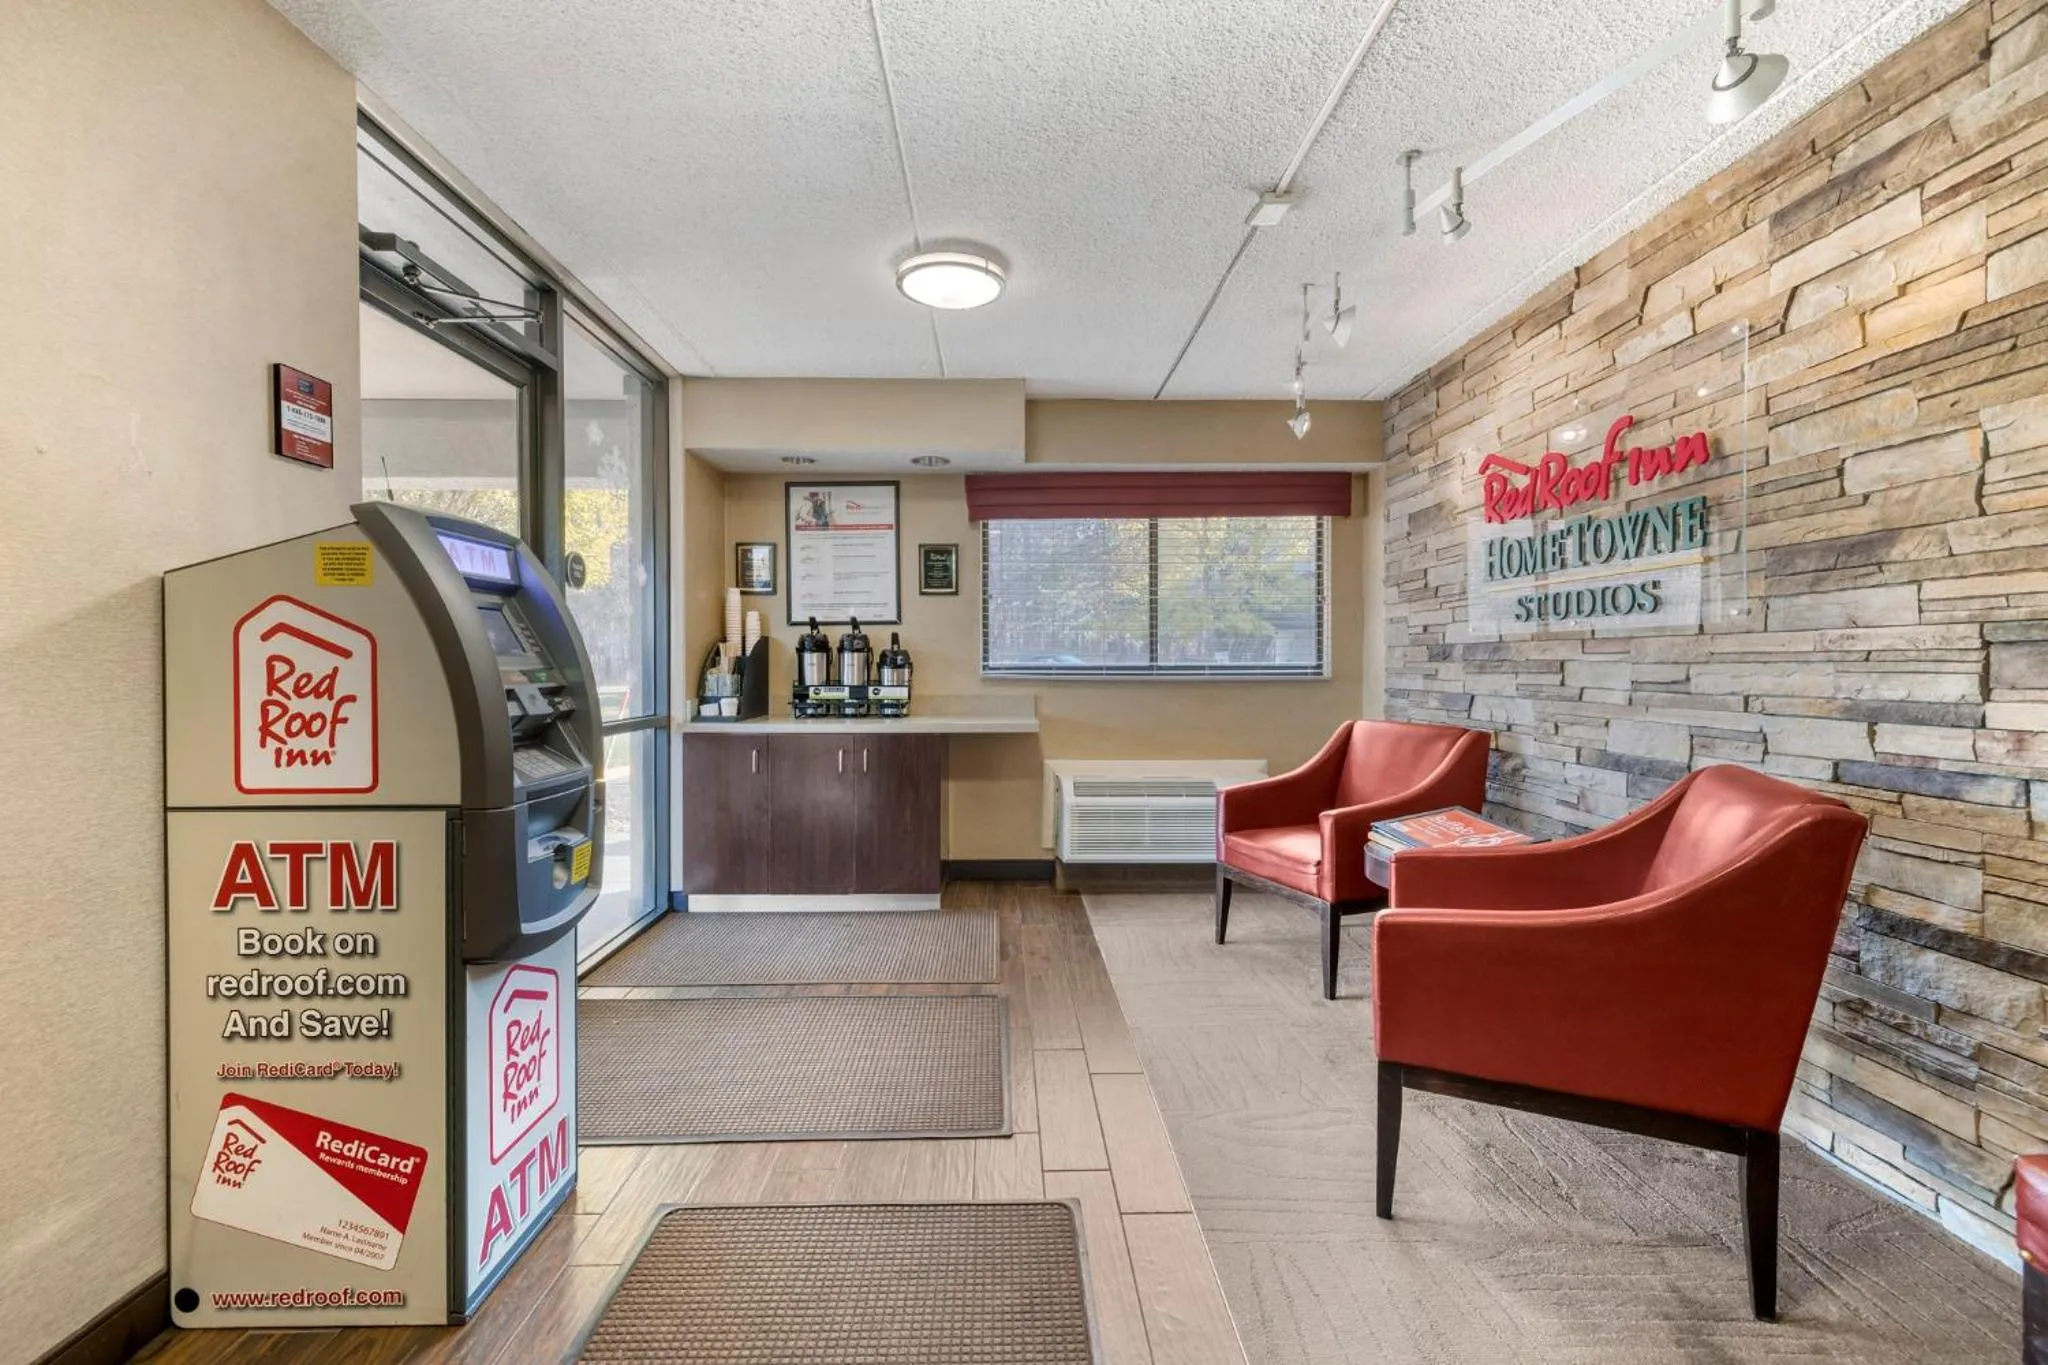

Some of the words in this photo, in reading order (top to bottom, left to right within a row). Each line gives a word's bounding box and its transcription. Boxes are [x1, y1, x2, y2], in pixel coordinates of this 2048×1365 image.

[1483, 468, 1539, 525] Red
[1539, 415, 1635, 511] Roof
[1628, 431, 1711, 486] Inn
[1483, 495, 1708, 583] HOMETOWNE
[1515, 579, 1661, 623] STUDIOS
[265, 654, 339, 701] Red
[258, 694, 358, 749] Roof
[210, 840, 398, 911] ATM
[237, 926, 325, 957] Book
[332, 932, 376, 956] on
[206, 967, 407, 998] redroof.com
[221, 1008, 290, 1039] And
[299, 1008, 391, 1039] Save!
[505, 1009, 543, 1062] Red
[216, 1062, 251, 1078] Join
[343, 1061, 400, 1080] Today!
[502, 1027, 550, 1112] Roof
[223, 1132, 258, 1159] Red
[212, 1151, 262, 1182] Roof
[319, 1151, 355, 1169] Rewards
[355, 1163, 408, 1185] membership
[477, 1112, 569, 1272] ATM
[338, 1219, 390, 1241] 1234567891
[211, 1287, 404, 1308] www.redroof.com
